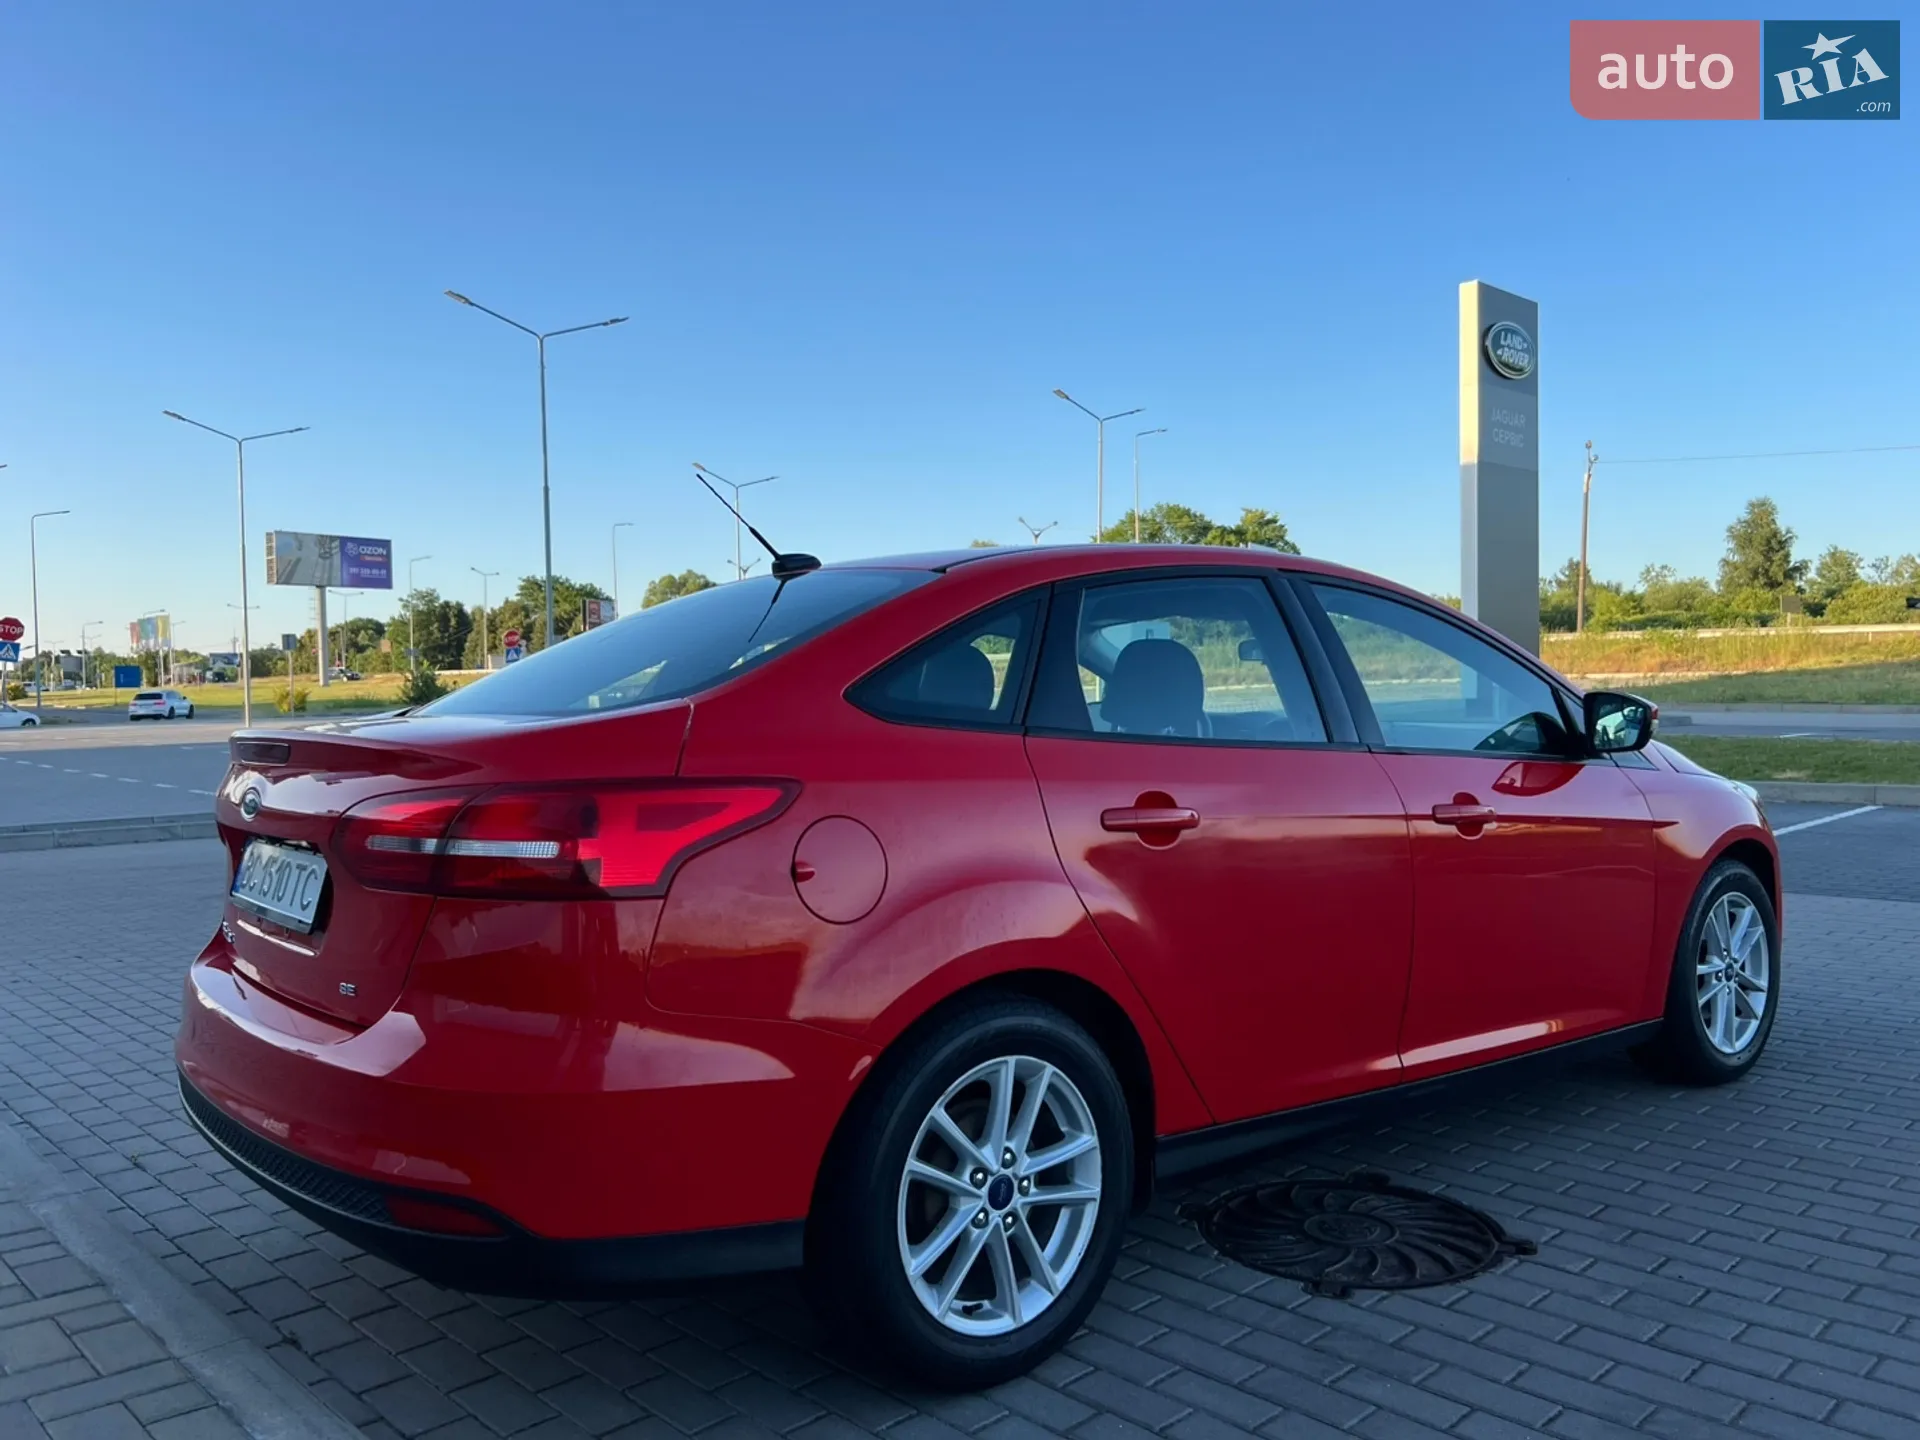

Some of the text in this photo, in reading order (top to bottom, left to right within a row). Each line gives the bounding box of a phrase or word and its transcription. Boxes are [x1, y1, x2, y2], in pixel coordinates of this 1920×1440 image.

[1500, 330, 1523, 350] LAND
[1491, 406, 1526, 429] JAGUAR
[358, 545, 387, 556] OZON
[339, 982, 356, 997] SE
